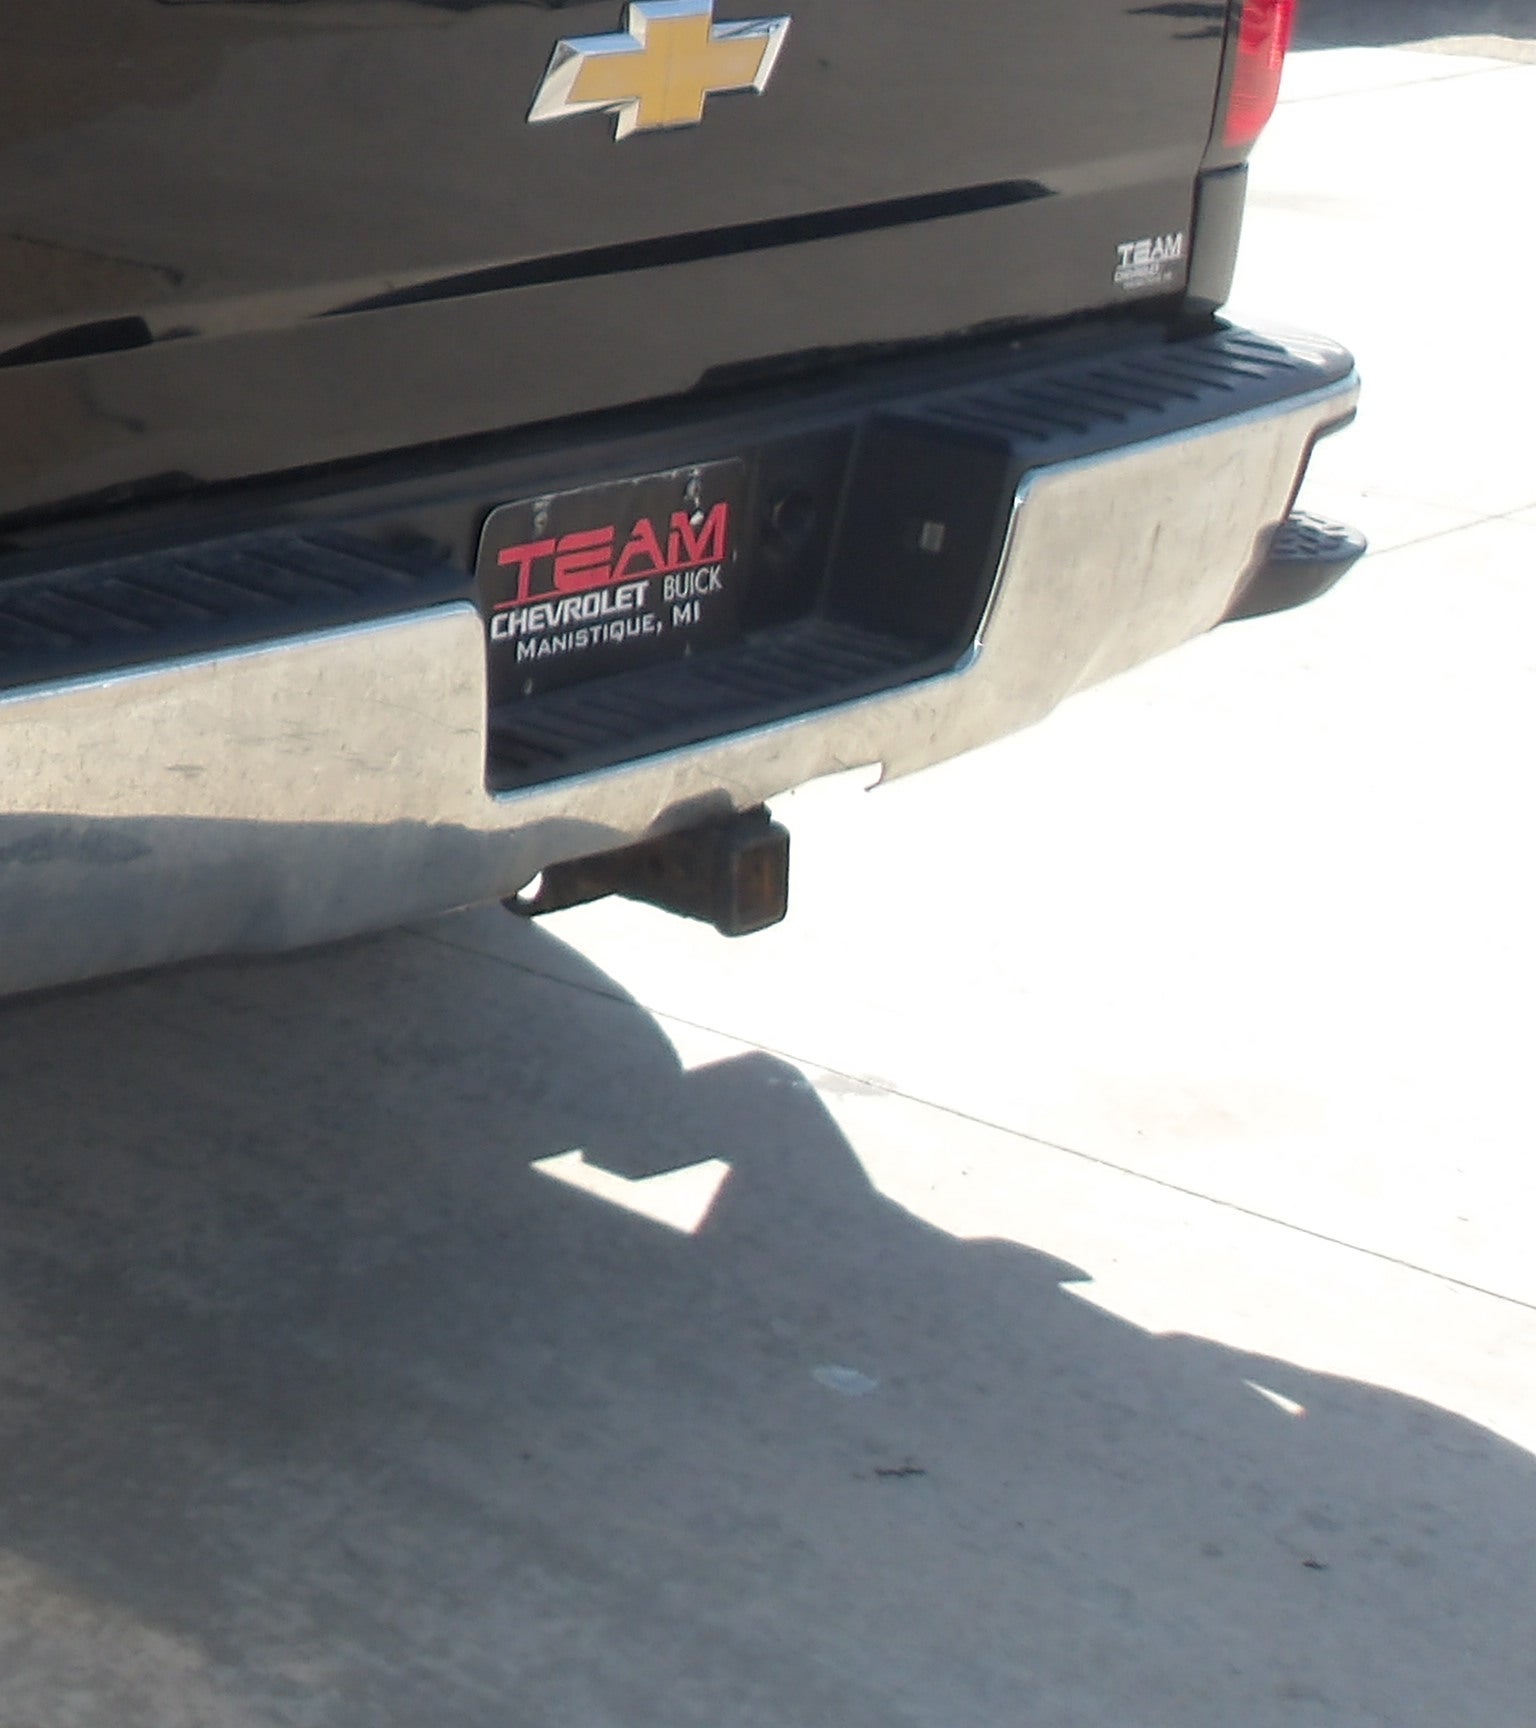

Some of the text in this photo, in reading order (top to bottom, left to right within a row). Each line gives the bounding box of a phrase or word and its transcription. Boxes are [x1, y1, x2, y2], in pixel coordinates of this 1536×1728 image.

[1116, 232, 1183, 268] TEAM
[495, 501, 729, 610] TEAM
[489, 564, 724, 641] CHEVROLET BUICK
[672, 599, 702, 628] MI
